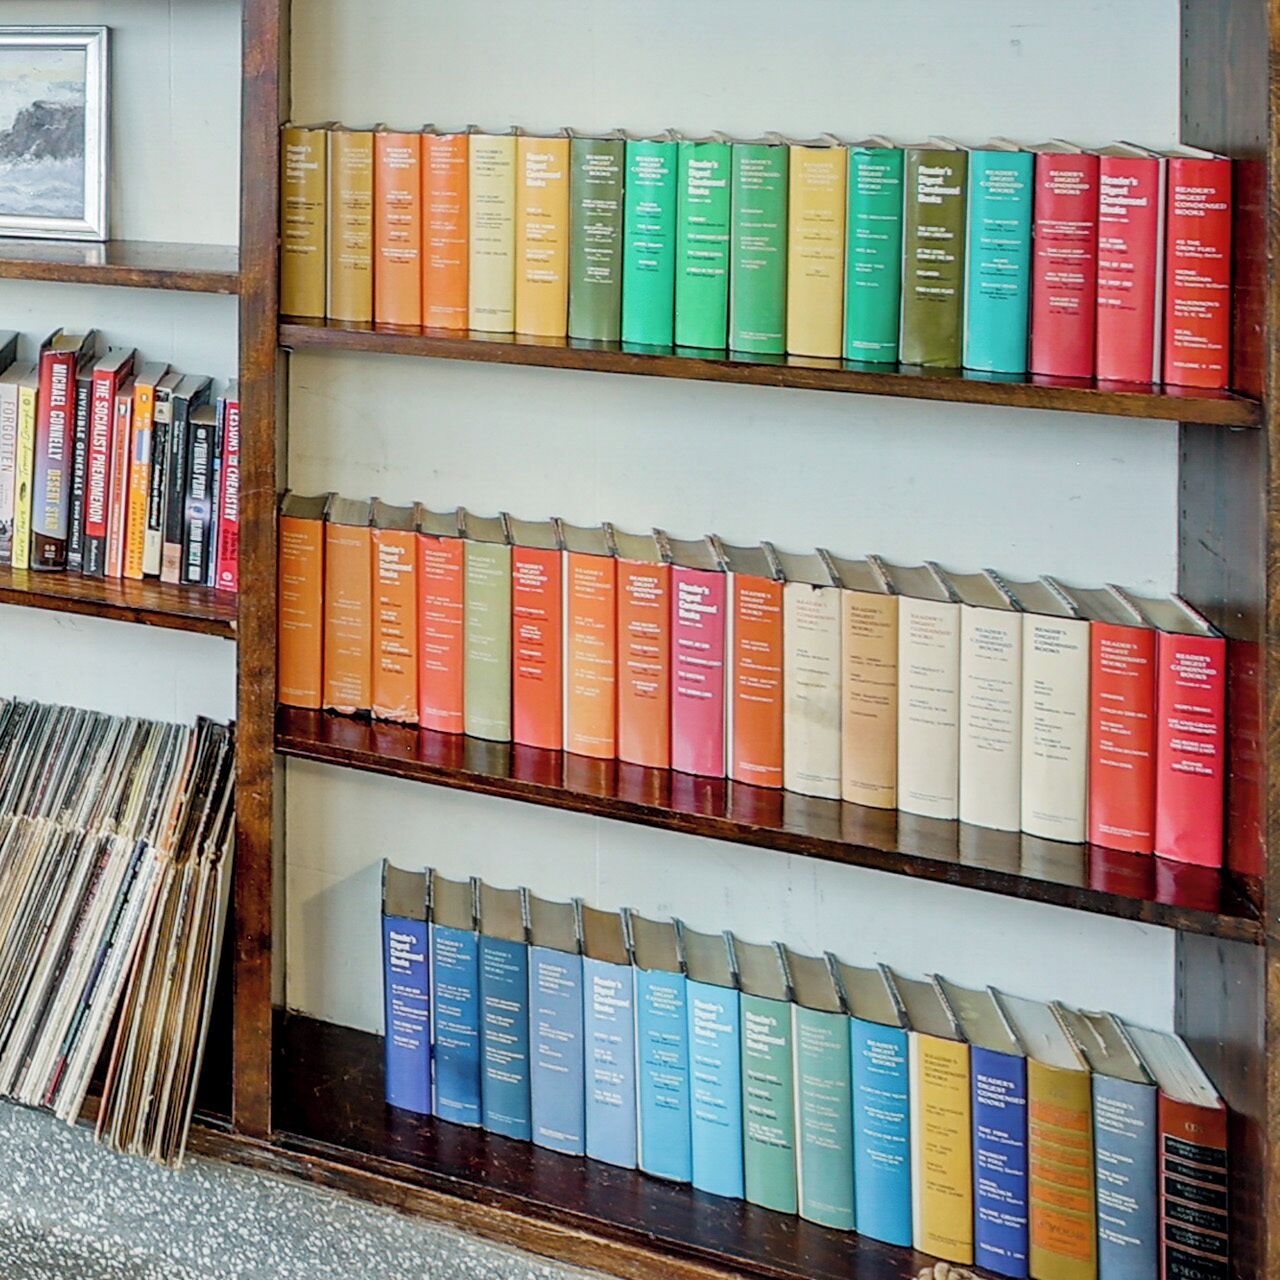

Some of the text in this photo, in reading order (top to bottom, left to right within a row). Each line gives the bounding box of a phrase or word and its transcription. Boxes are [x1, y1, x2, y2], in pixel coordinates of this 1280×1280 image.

[1174, 187, 1216, 195] READER'S
[1174, 194, 1207, 202] DIGEST
[1174, 201, 1227, 210] CONDENSED
[1174, 208, 1205, 217] BOOKS
[48, 363, 67, 461] MICHAEL CONNELLY
[1, 401, 16, 473] FORGOTTEN
[74, 388, 87, 496] INVISIBLE GENERALS
[89, 379, 110, 523] THE SOCIALIST PHENOMENON
[224, 408, 238, 522] LESSONS CHEMISTRY
[192, 474, 206, 499] PERRY
[45, 469, 62, 530] DESERT STAR
[977, 1074, 1015, 1088] READER'S
[977, 1082, 1006, 1093] DIGEST
[977, 1089, 1025, 1105] CONDENSED
[977, 1096, 1005, 1108] BOOKS
